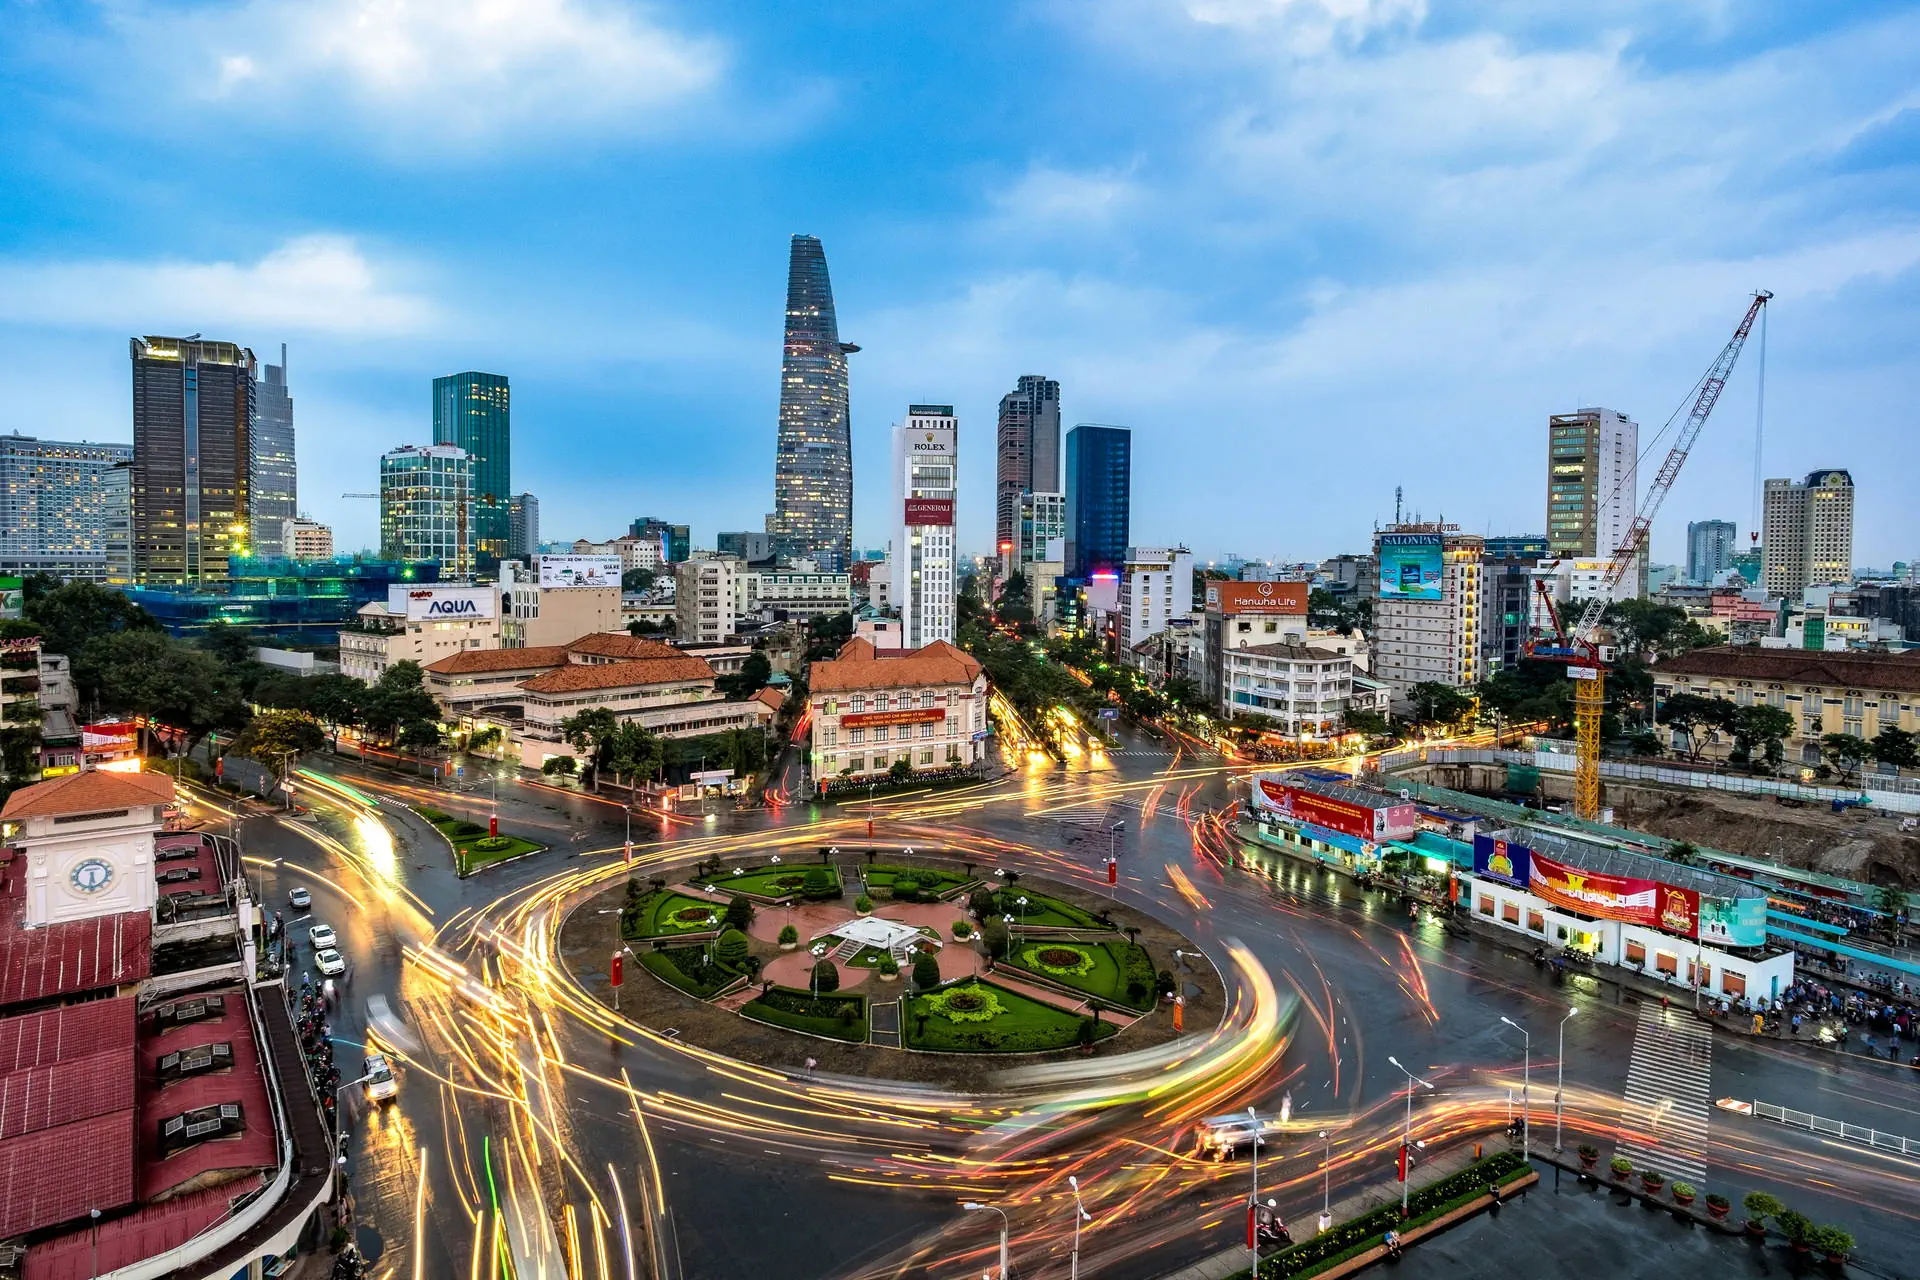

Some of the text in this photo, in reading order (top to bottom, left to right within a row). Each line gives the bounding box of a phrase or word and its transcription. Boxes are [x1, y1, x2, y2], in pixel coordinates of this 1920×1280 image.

[914, 443, 946, 451] ROLEX
[1436, 523, 1460, 532] HOTEL
[1383, 536, 1440, 545] SALONPAS
[409, 590, 433, 598] SANYO
[1234, 597, 1297, 606] Hanwha Life
[429, 601, 476, 614] AQUA
